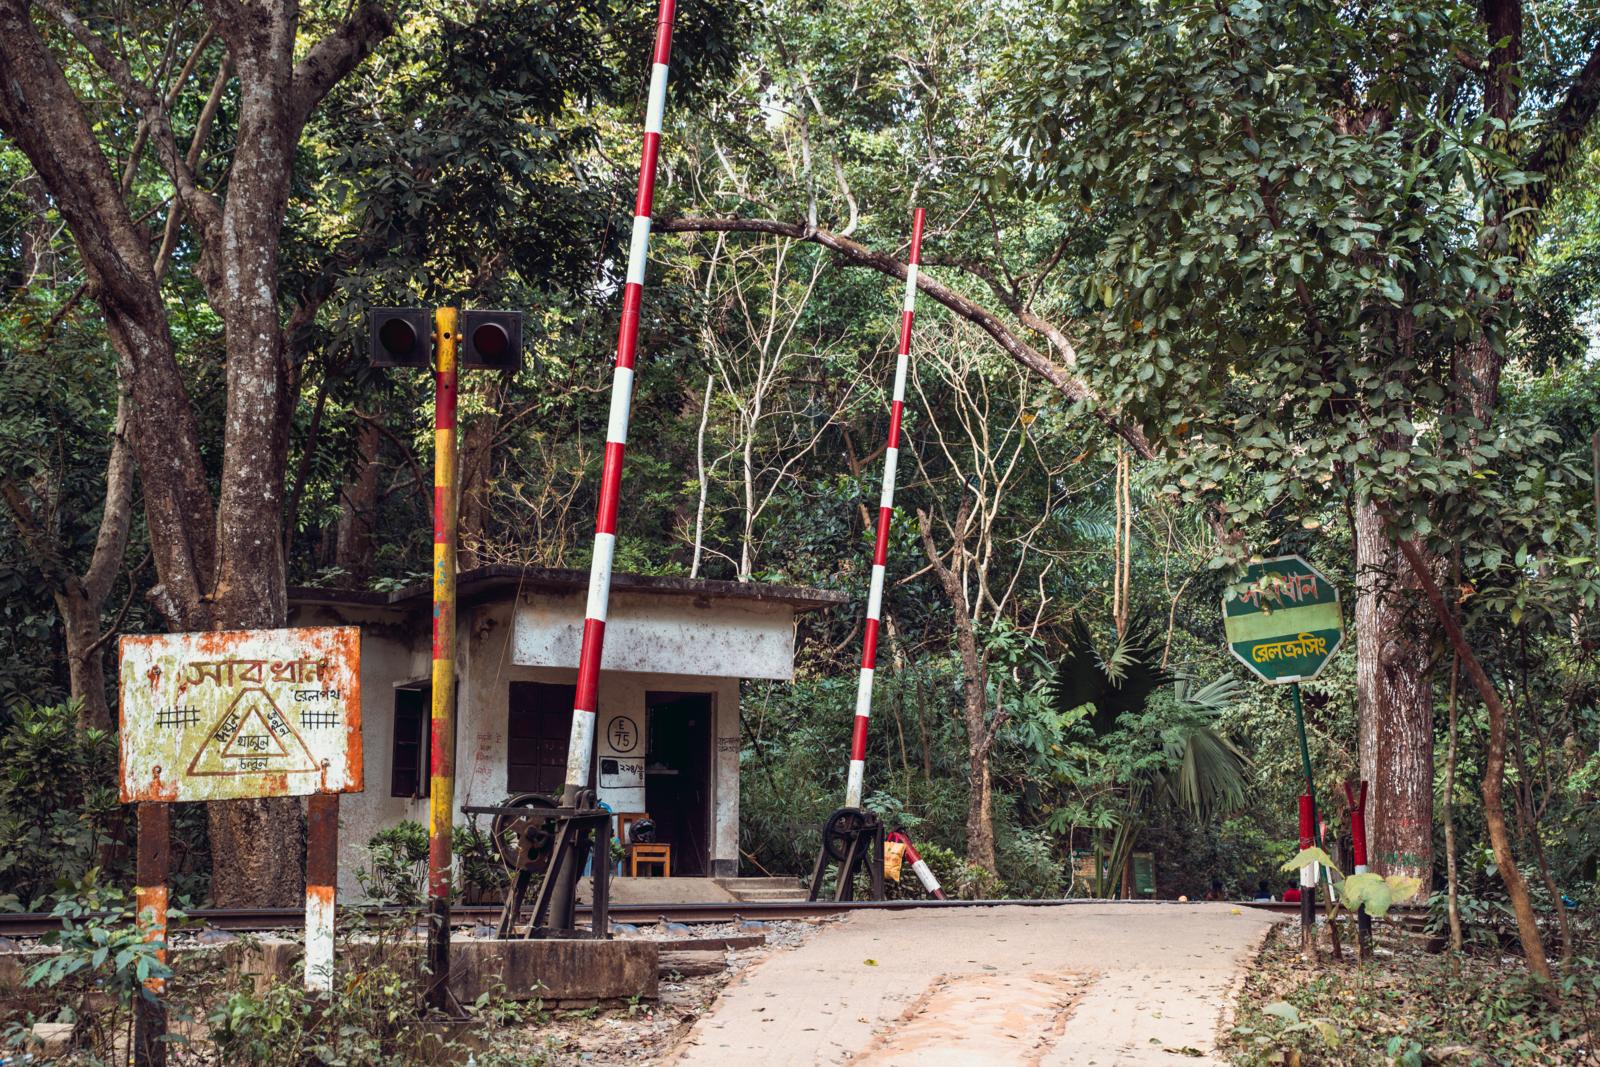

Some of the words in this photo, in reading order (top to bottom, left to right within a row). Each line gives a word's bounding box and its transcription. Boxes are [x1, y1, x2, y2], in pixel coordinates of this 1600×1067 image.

[1252, 632, 1327, 661] রেলক্রসিং
[186, 657, 327, 686] সাবধান
[294, 690, 340, 702] রেলপথ
[619, 720, 624, 730] E
[237, 736, 269, 750] থামুন
[614, 734, 629, 746] 75
[240, 758, 268, 770] চলুন
